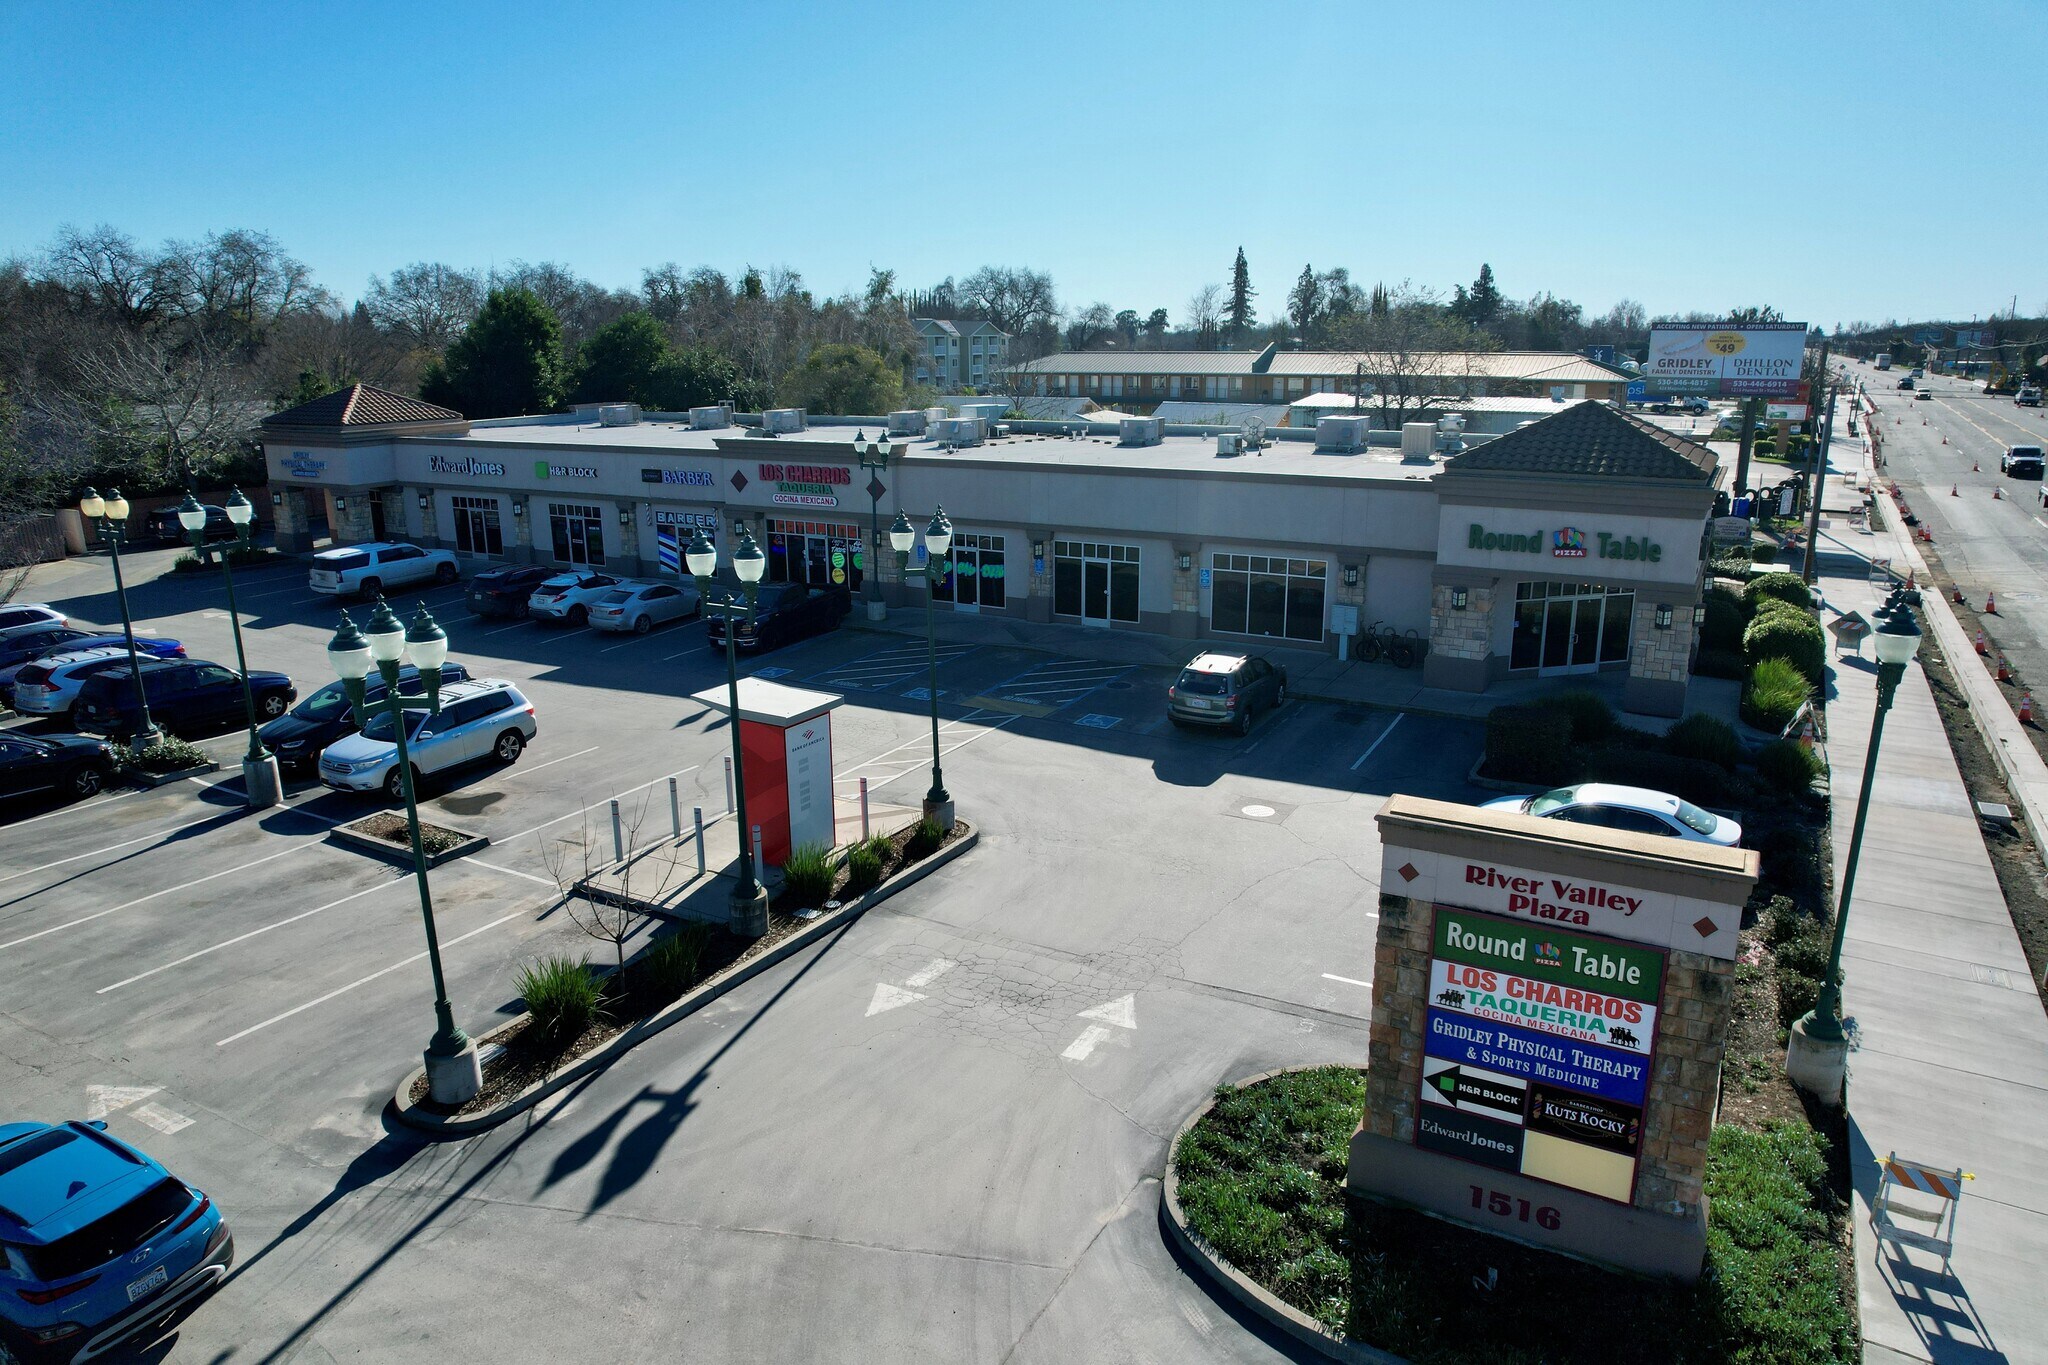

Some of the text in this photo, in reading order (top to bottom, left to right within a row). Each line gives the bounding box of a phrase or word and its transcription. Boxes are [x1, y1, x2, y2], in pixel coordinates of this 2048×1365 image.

[1715, 343, 1735, 353] $49
[1657, 358, 1713, 368] GRIDLEY
[1733, 358, 1794, 367] DHILLON
[1736, 367, 1788, 376] DENTAL
[1627, 385, 1645, 397] psi
[1733, 380, 1787, 388] 530-446-6914
[549, 466, 598, 478] H&R BLOCK
[663, 470, 714, 486] BARBER
[759, 463, 851, 485] LOS CHARROS
[776, 481, 834, 494] TAQUERIA
[774, 494, 835, 506] COCINA MEXICANA
[657, 512, 716, 527] BARBER
[1468, 524, 1662, 563] Round Table
[1554, 549, 1584, 557] PIZZA
[808, 737, 825, 746] AMERICA
[1465, 864, 1643, 916] River Valley
[1508, 893, 1590, 926] Plaza
[1446, 921, 1641, 985] Round Table
[1534, 957, 1562, 968] PIZZA
[1446, 964, 1643, 1024] LOS CHARROS
[1465, 989, 1607, 1035] TAQUERIA
[1473, 1006, 1597, 1042] COCINA MEXICANA
[1433, 1017, 1641, 1081] GRIDLEY PHYSICAL THERAPY
[1466, 1046, 1600, 1090] & SPORTS MEDICINE
[1458, 1083, 1518, 1105] H&R BLOCK
[1544, 1102, 1626, 1134] KUTS KOCKY
[1468, 1184, 1561, 1231] 1516
[131, 1272, 166, 1297] 8ZGV762
